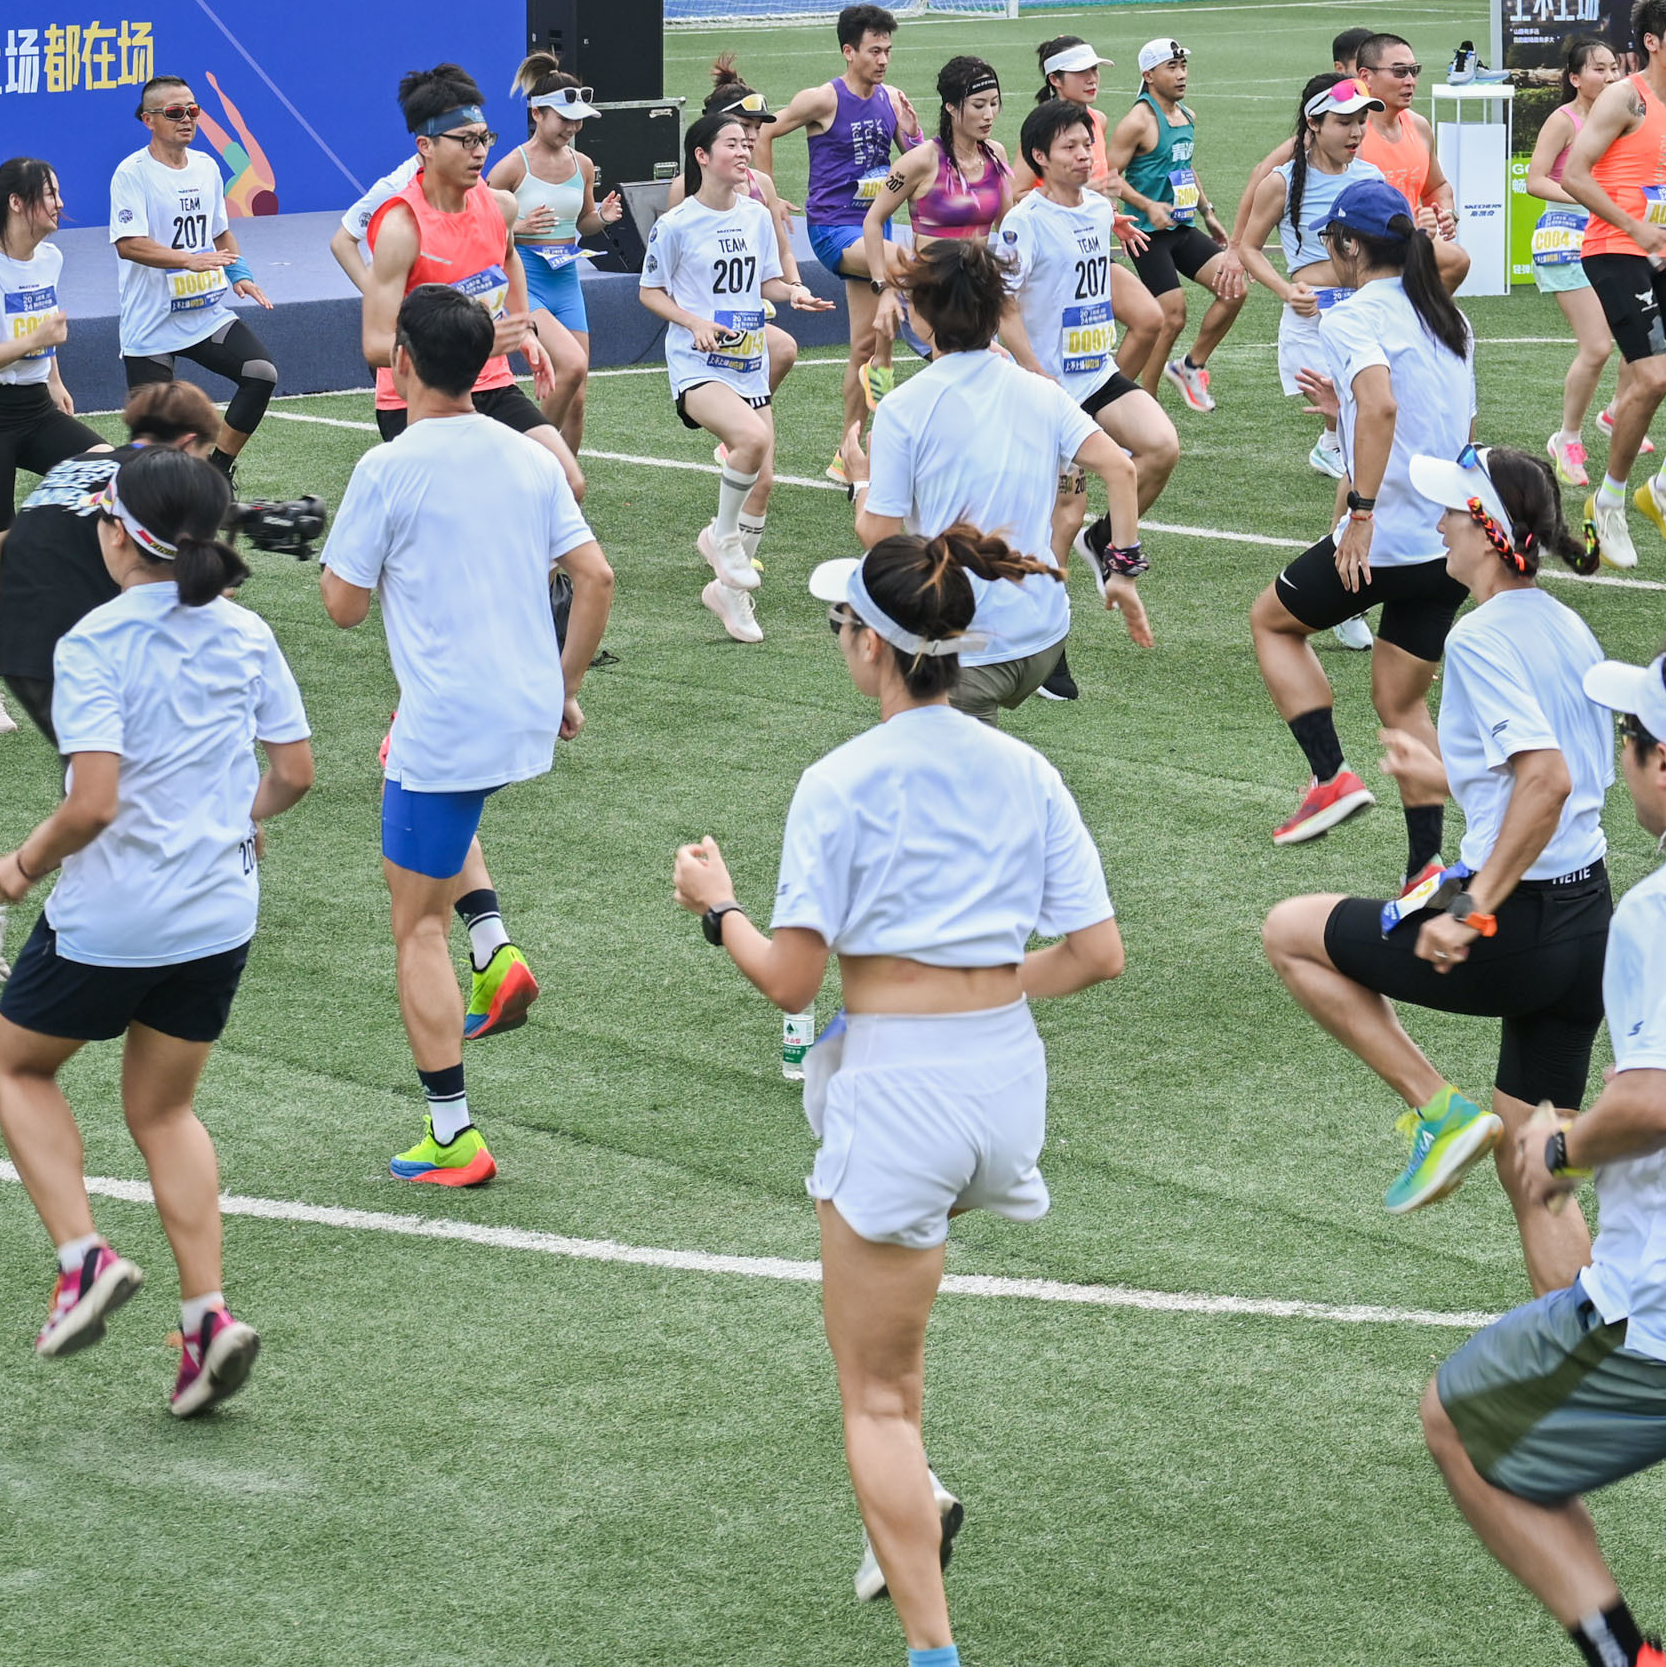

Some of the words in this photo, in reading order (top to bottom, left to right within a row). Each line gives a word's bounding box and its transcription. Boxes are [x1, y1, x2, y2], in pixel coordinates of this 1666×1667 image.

[885, 175, 906, 194] 207
[179, 197, 201, 212] TEAM
[171, 214, 207, 249] 207
[718, 238, 748, 254] TEAM
[1077, 236, 1101, 255] TEAM
[713, 256, 756, 294] 207
[1074, 256, 1108, 300] 207
